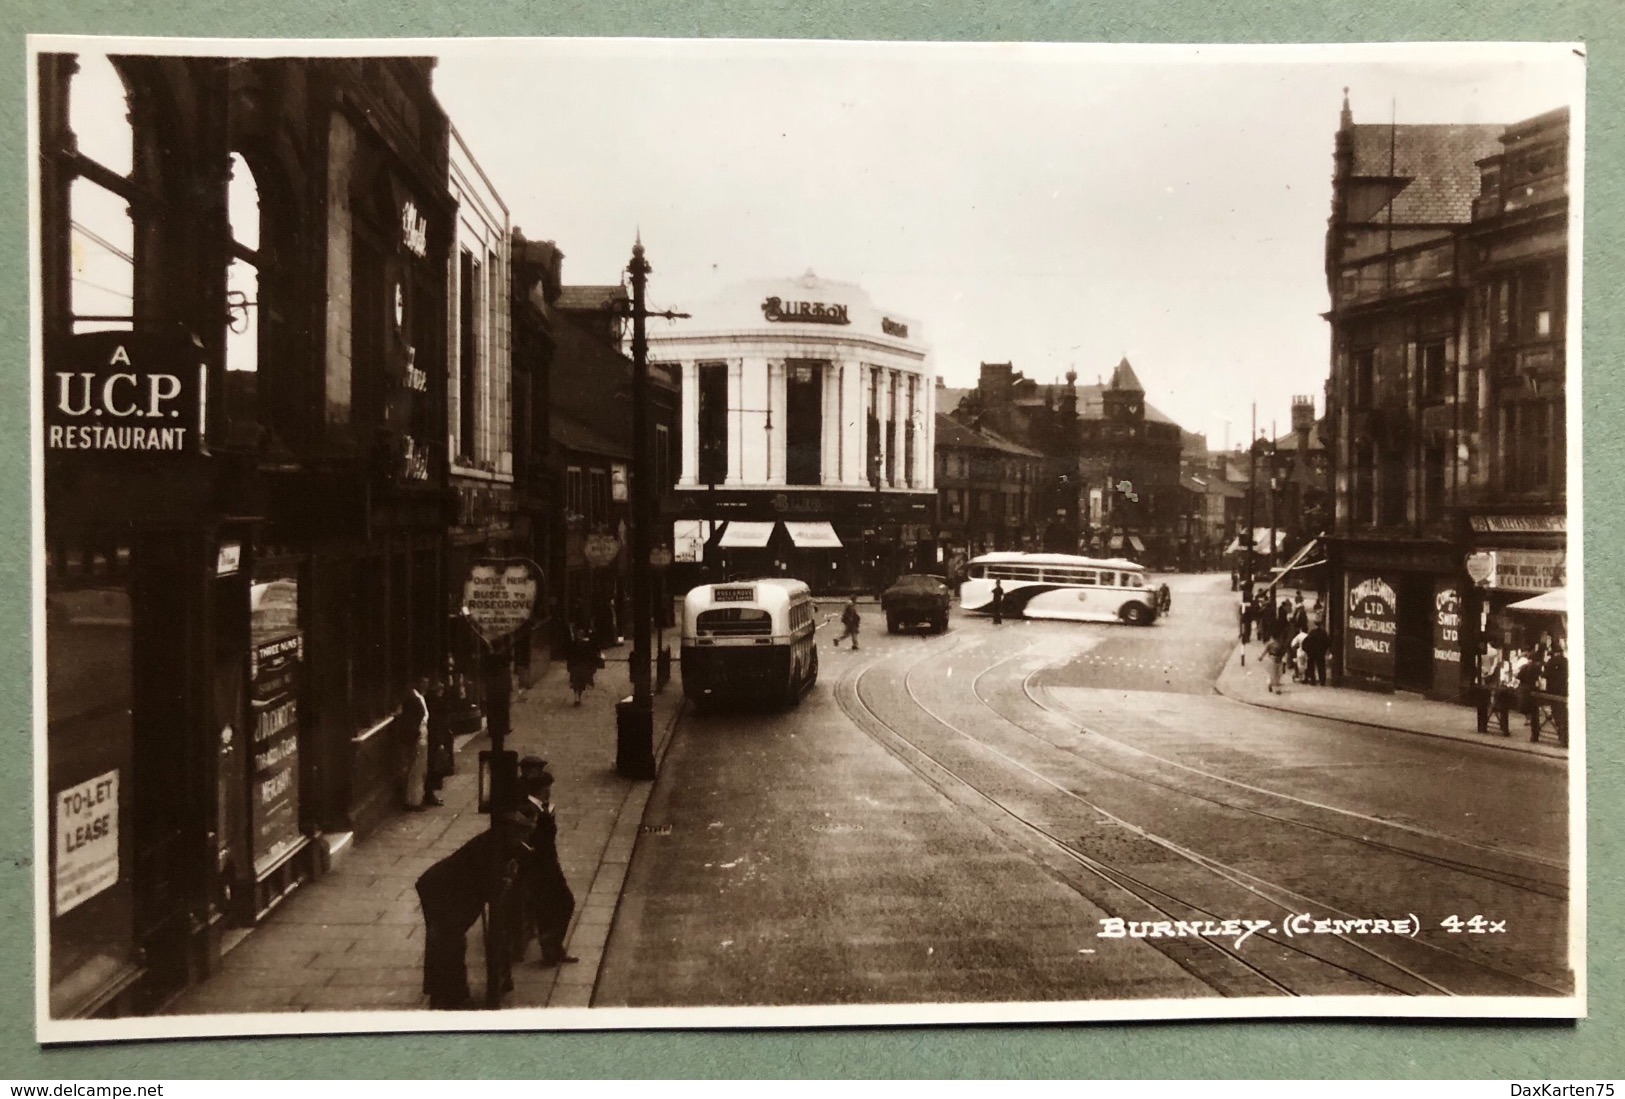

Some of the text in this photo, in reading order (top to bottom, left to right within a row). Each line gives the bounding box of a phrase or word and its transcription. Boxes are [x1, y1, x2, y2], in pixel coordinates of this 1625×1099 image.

[110, 345, 131, 365] A
[56, 372, 182, 418] U.C.P.
[50, 425, 187, 451] RESTAURANT
[473, 577, 502, 585] QUEUE
[473, 591, 509, 599] BUSES
[468, 600, 533, 610] ROSEGROVE
[259, 643, 280, 659] THREE
[1355, 635, 1391, 653] BURNLEY
[63, 779, 113, 818] TO-LET
[65, 813, 111, 853] LEASE
